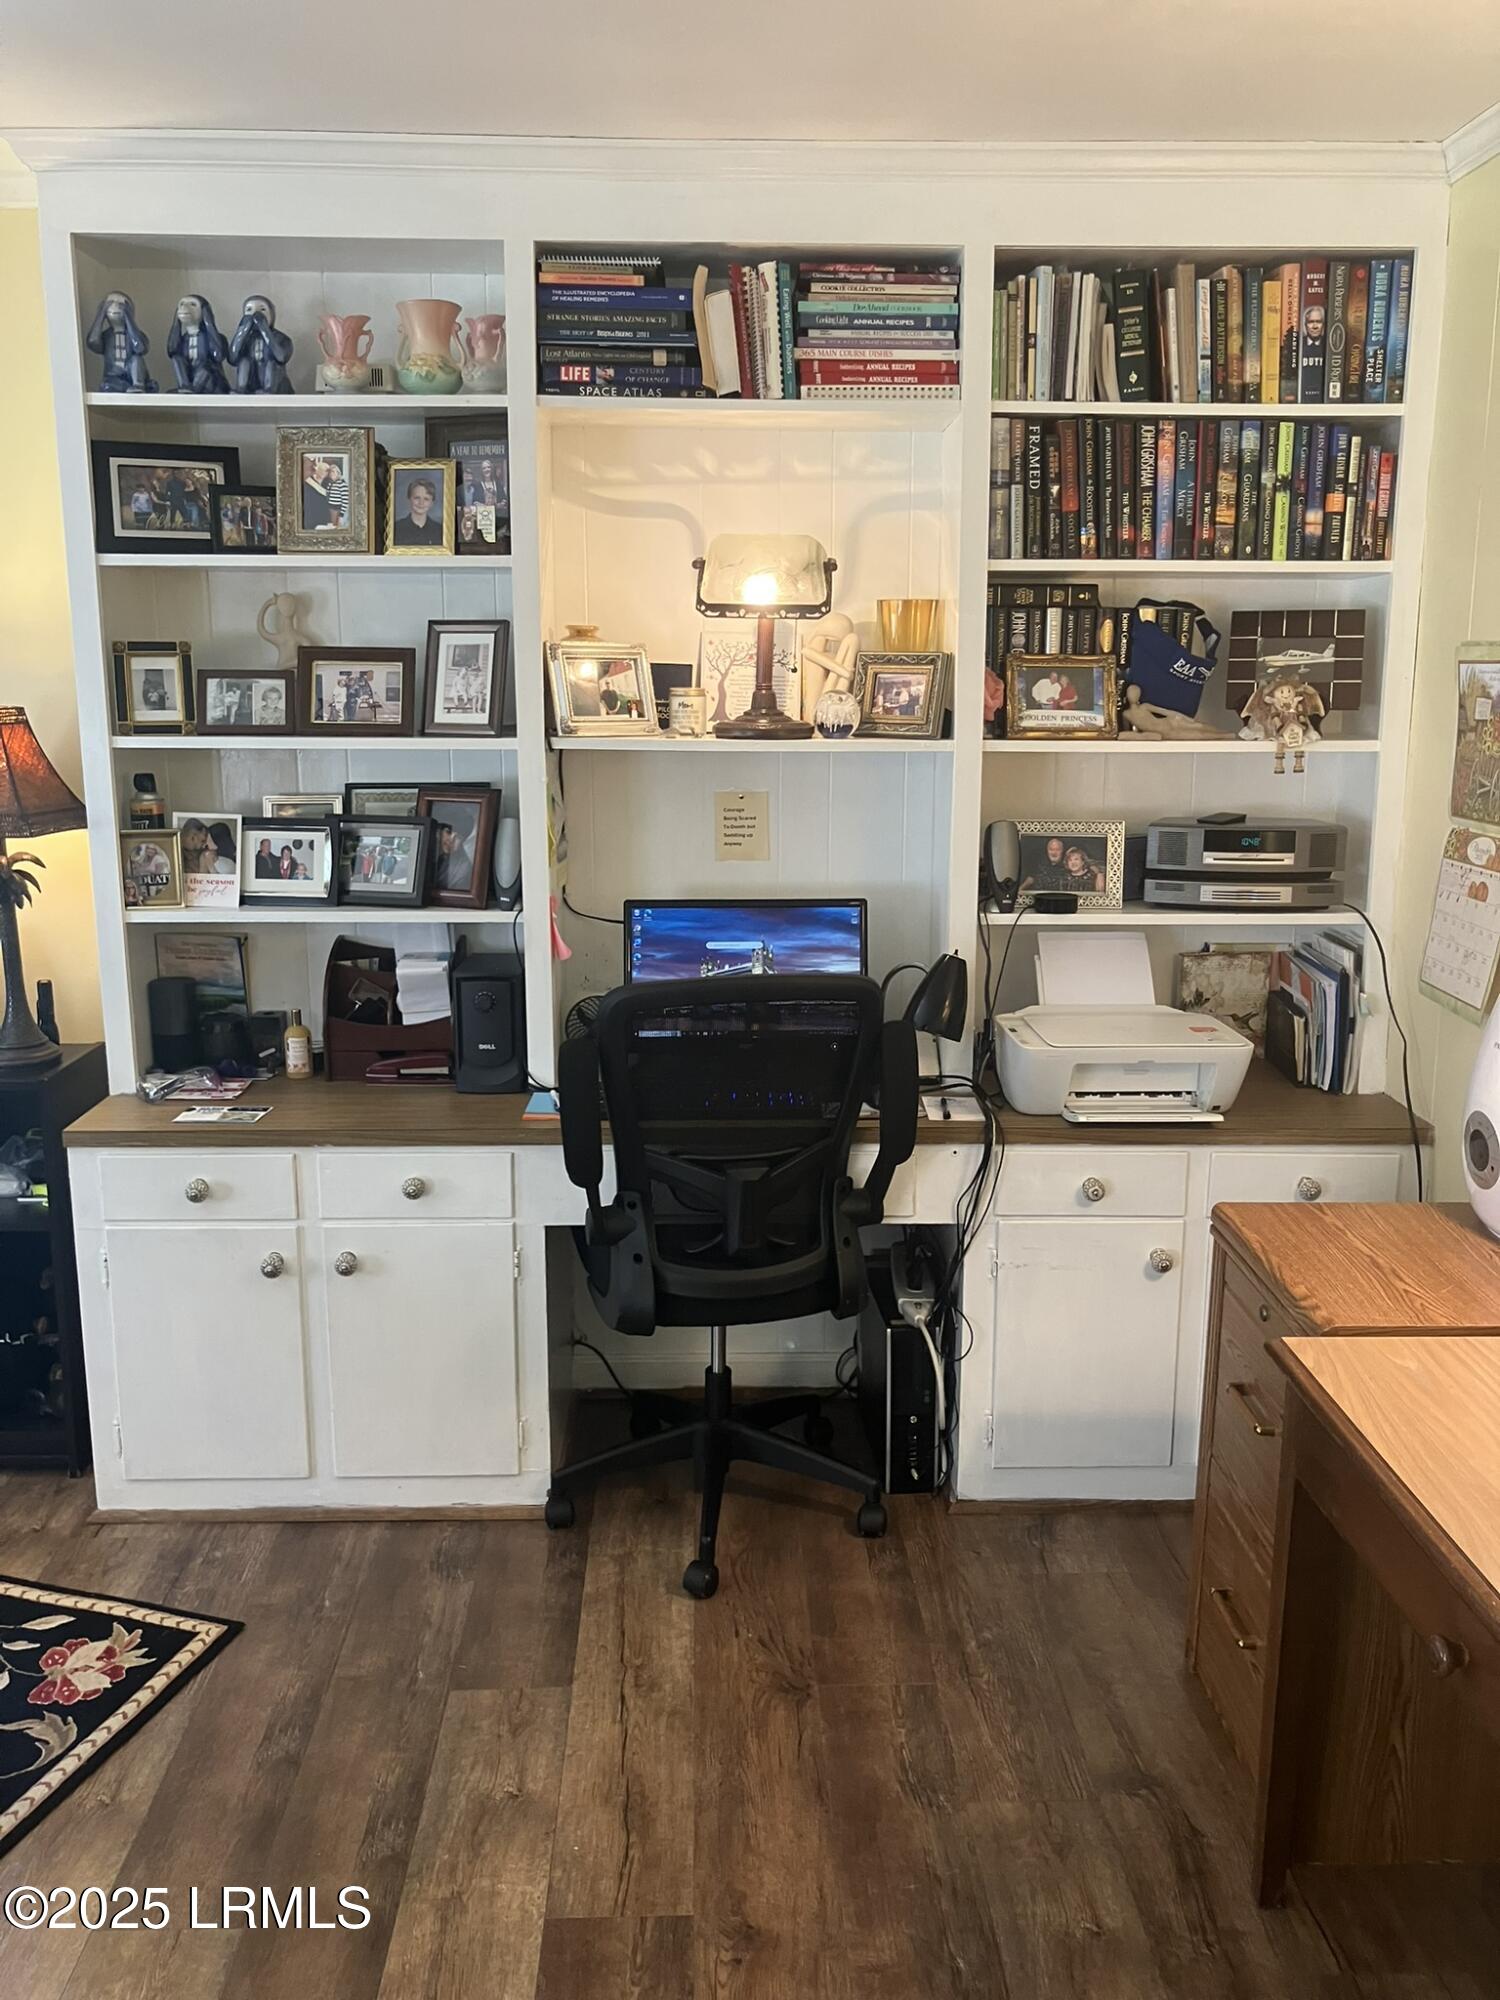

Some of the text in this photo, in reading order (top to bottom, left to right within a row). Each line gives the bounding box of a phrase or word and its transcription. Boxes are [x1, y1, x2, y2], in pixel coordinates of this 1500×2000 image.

[1216, 295, 1225, 320] JAMES
[886, 318, 915, 326] RECIPES
[1372, 301, 1387, 342] ROBERTS
[1216, 322, 1224, 364] PATTERSON
[560, 366, 590, 381] LIFE
[1302, 356, 1324, 366] DUTY
[1366, 358, 1374, 382] PLACE
[1376, 350, 1384, 383] SHELTER
[579, 386, 662, 397] SPACE ATLAS
[894, 376, 918, 384] RECIPES
[1223, 428, 1232, 464] GRISHAM
[1301, 426, 1309, 446] JOHN
[1317, 426, 1325, 448] JOHN
[450, 446, 456, 456] A
[456, 446, 470, 456] YEAR
[478, 444, 505, 456] REMEMBER
[1029, 426, 1040, 490] FRAMED
[1179, 431, 1188, 470] GRISHAM
[1299, 446, 1308, 480] GRISHAM
[1140, 425, 1155, 542] JOHN GRISHAM THE CHAMBER
[1331, 433, 1347, 544] JOHN GRISHAM PARTNERS
[1380, 473, 1391, 489] JOHN
[1086, 486, 1094, 520] ROOSTER
[1177, 488, 1185, 518] MERCY
[1243, 474, 1252, 522] GUARDIANS
[1378, 490, 1391, 518] GRISHAM
[1296, 496, 1304, 527] CAMINO
[1012, 612, 1026, 634] JOHN
[1183, 612, 1191, 631] JOHN
[1120, 632, 1128, 664] GRISHAM
[1173, 657, 1198, 677] EAA
[1023, 714, 1098, 722] GOLDEN PRINCESS
[190, 878, 235, 886] the season
